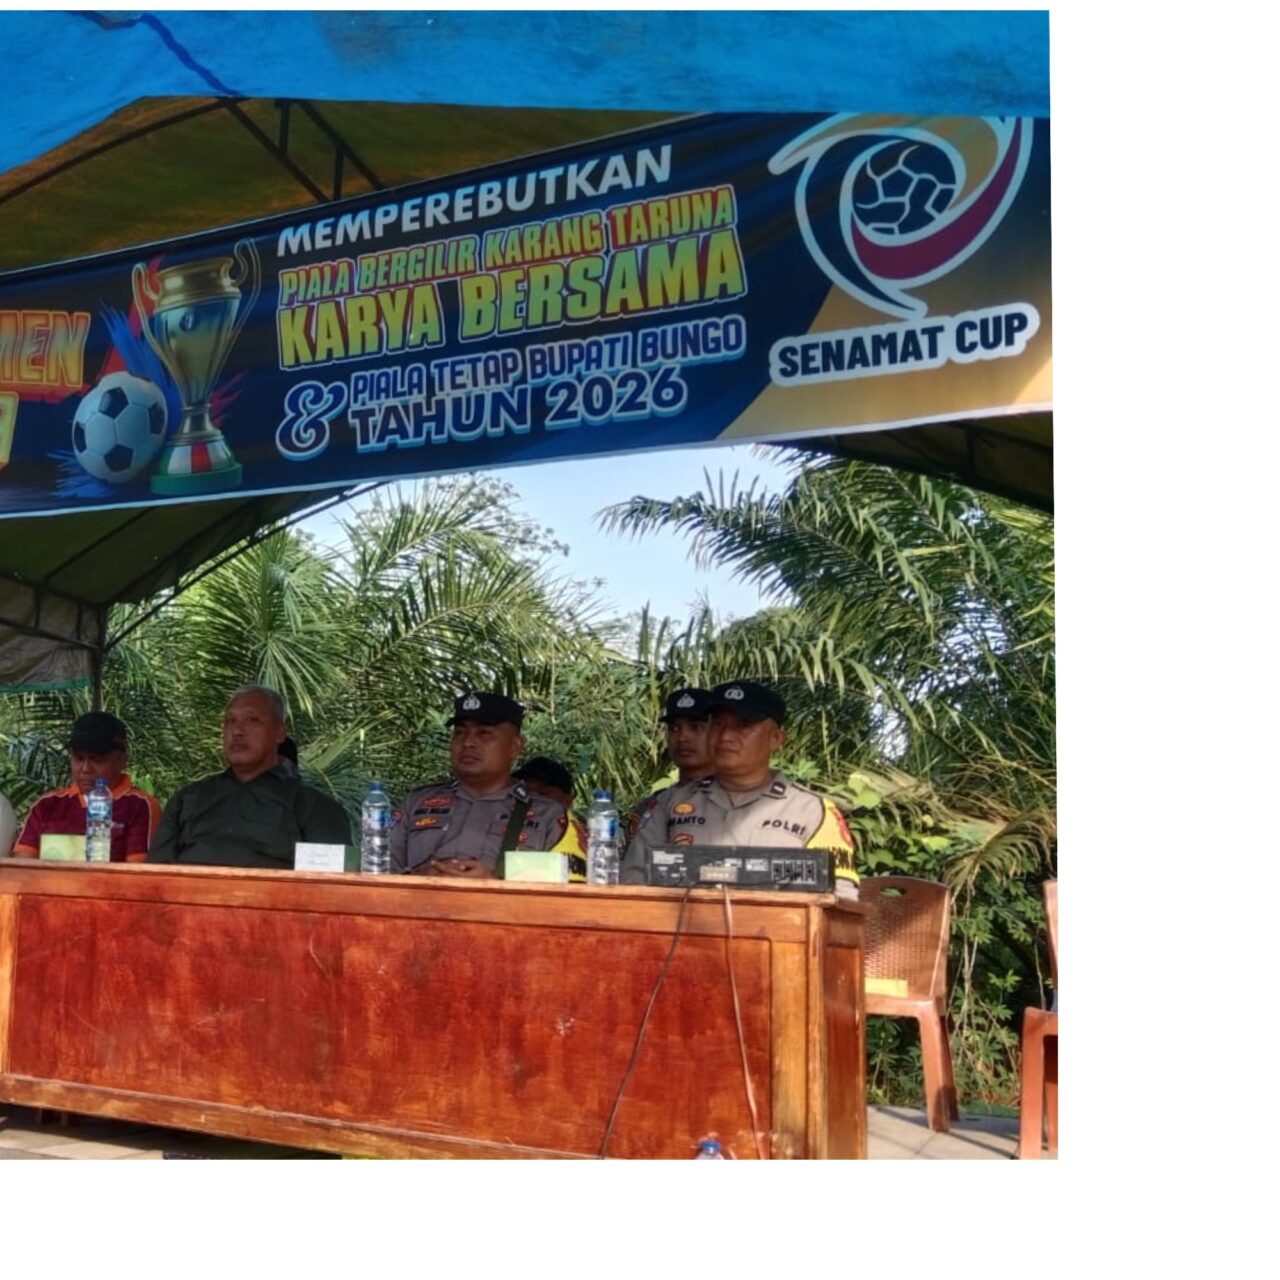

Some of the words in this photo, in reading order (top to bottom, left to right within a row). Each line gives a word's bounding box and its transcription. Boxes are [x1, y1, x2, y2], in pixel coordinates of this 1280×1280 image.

[277, 145, 673, 257] MEMPEREBUTKAN
[280, 262, 352, 305] PIALA
[358, 236, 477, 293] BERGILIR
[484, 213, 604, 272] KARANG
[608, 186, 735, 244] TARUNA
[279, 283, 444, 367] KARYA
[460, 229, 747, 340] BERSAMA
[351, 365, 422, 404] PIALA
[432, 351, 520, 390] TETAP
[529, 333, 631, 379] BUPATI
[641, 317, 745, 362] BUNGO
[779, 326, 943, 378] SENAMAT
[955, 313, 1028, 354] CUP
[350, 388, 530, 447] TAHUN
[547, 367, 686, 422] 2026
[761, 818, 807, 836] POLRI
